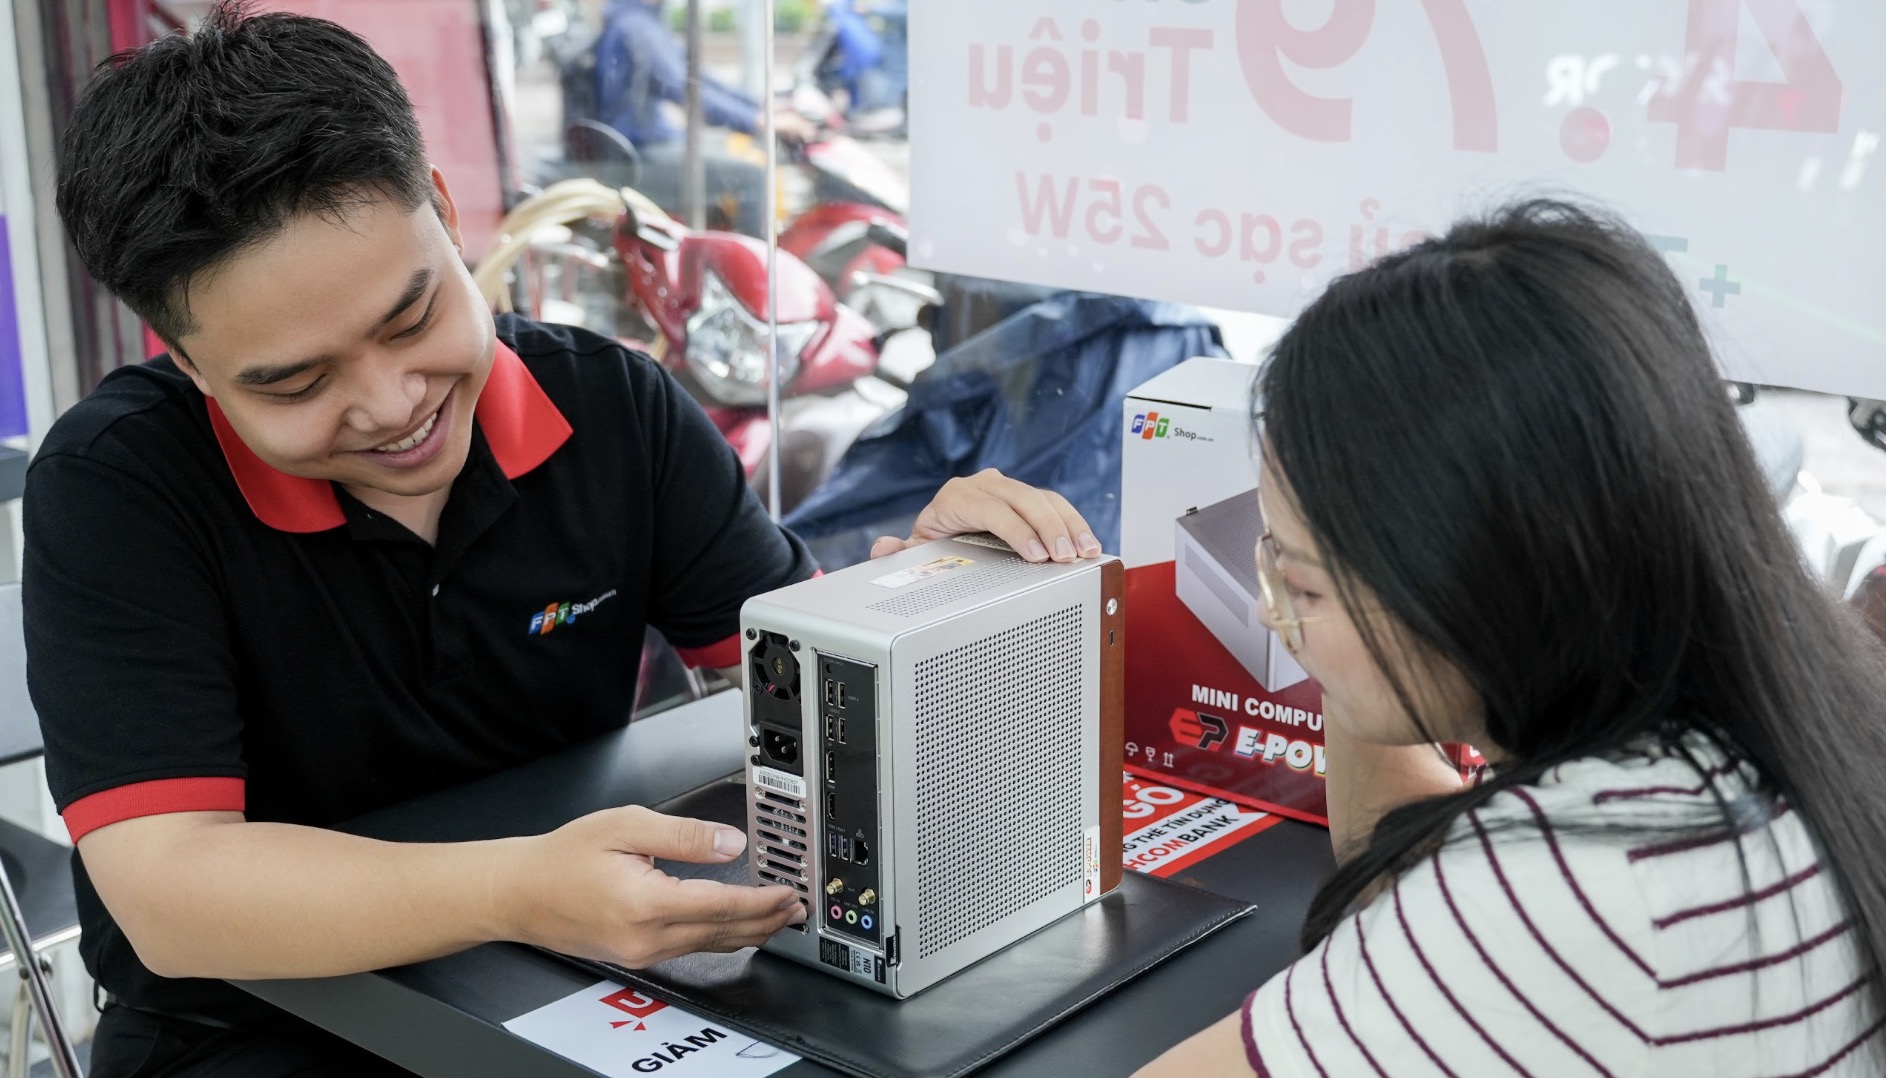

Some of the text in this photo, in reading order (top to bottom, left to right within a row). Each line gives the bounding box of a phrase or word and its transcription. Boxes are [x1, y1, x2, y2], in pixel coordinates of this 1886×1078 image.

[1131, 414, 1169, 437] FPT
[530, 604, 570, 632] FPT
[1192, 684, 1323, 731] MINI COMPU
[863, 957, 872, 974] N10
[631, 1027, 728, 1073] GIẢM
